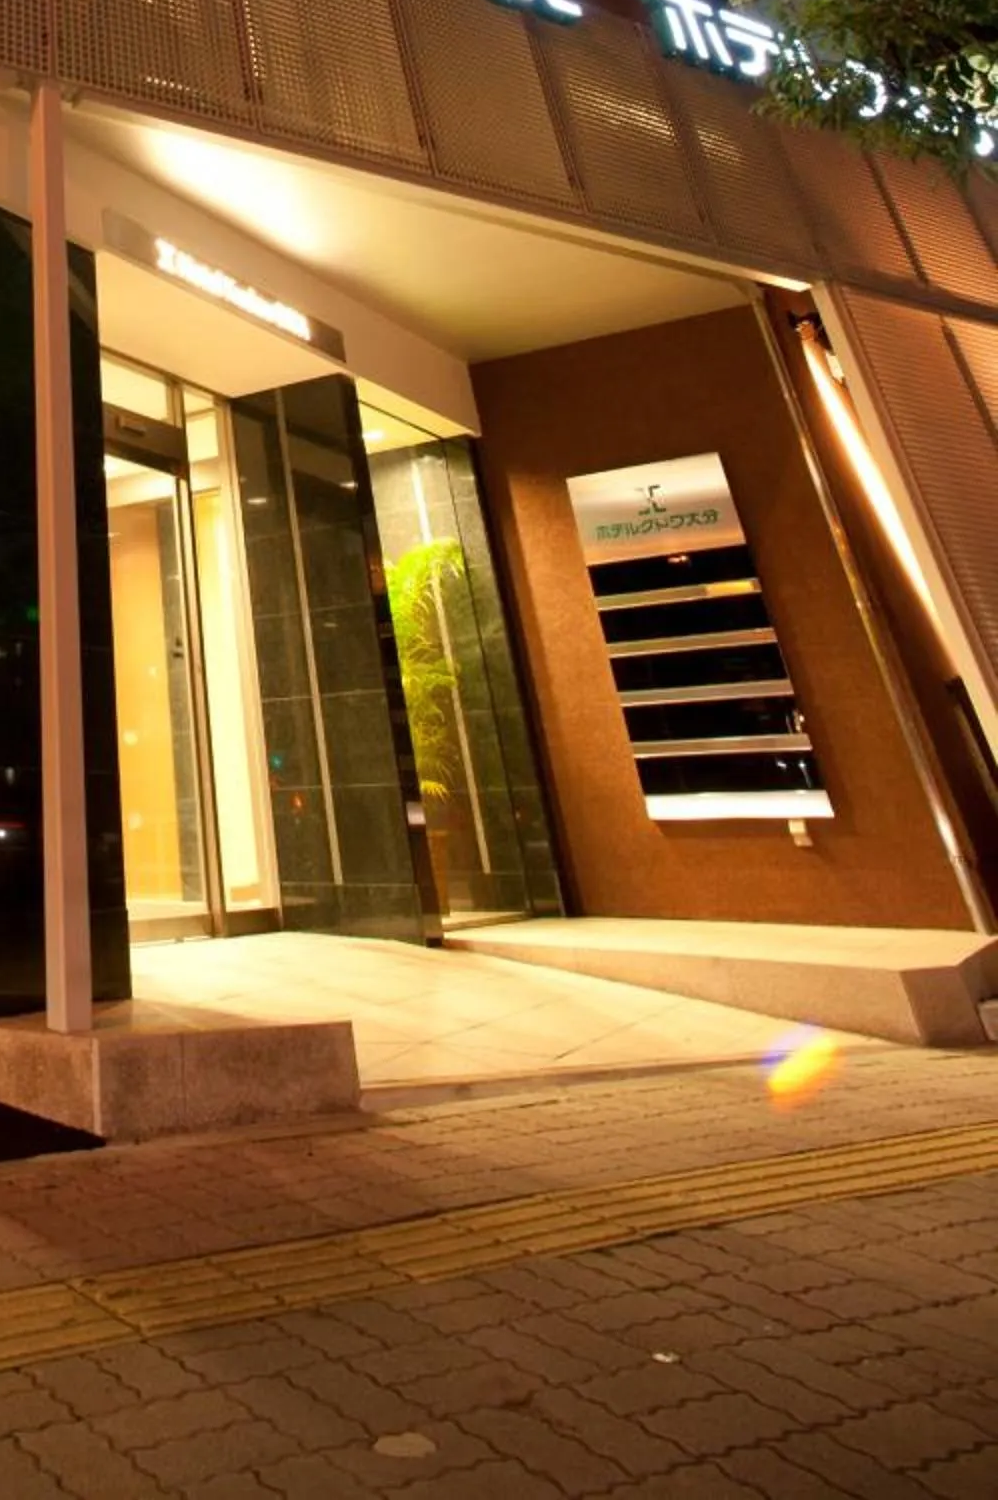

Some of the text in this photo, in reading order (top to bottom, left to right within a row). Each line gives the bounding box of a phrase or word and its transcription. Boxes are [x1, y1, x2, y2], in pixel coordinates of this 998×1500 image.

[595, 508, 720, 541] ホテルクドウ大分
